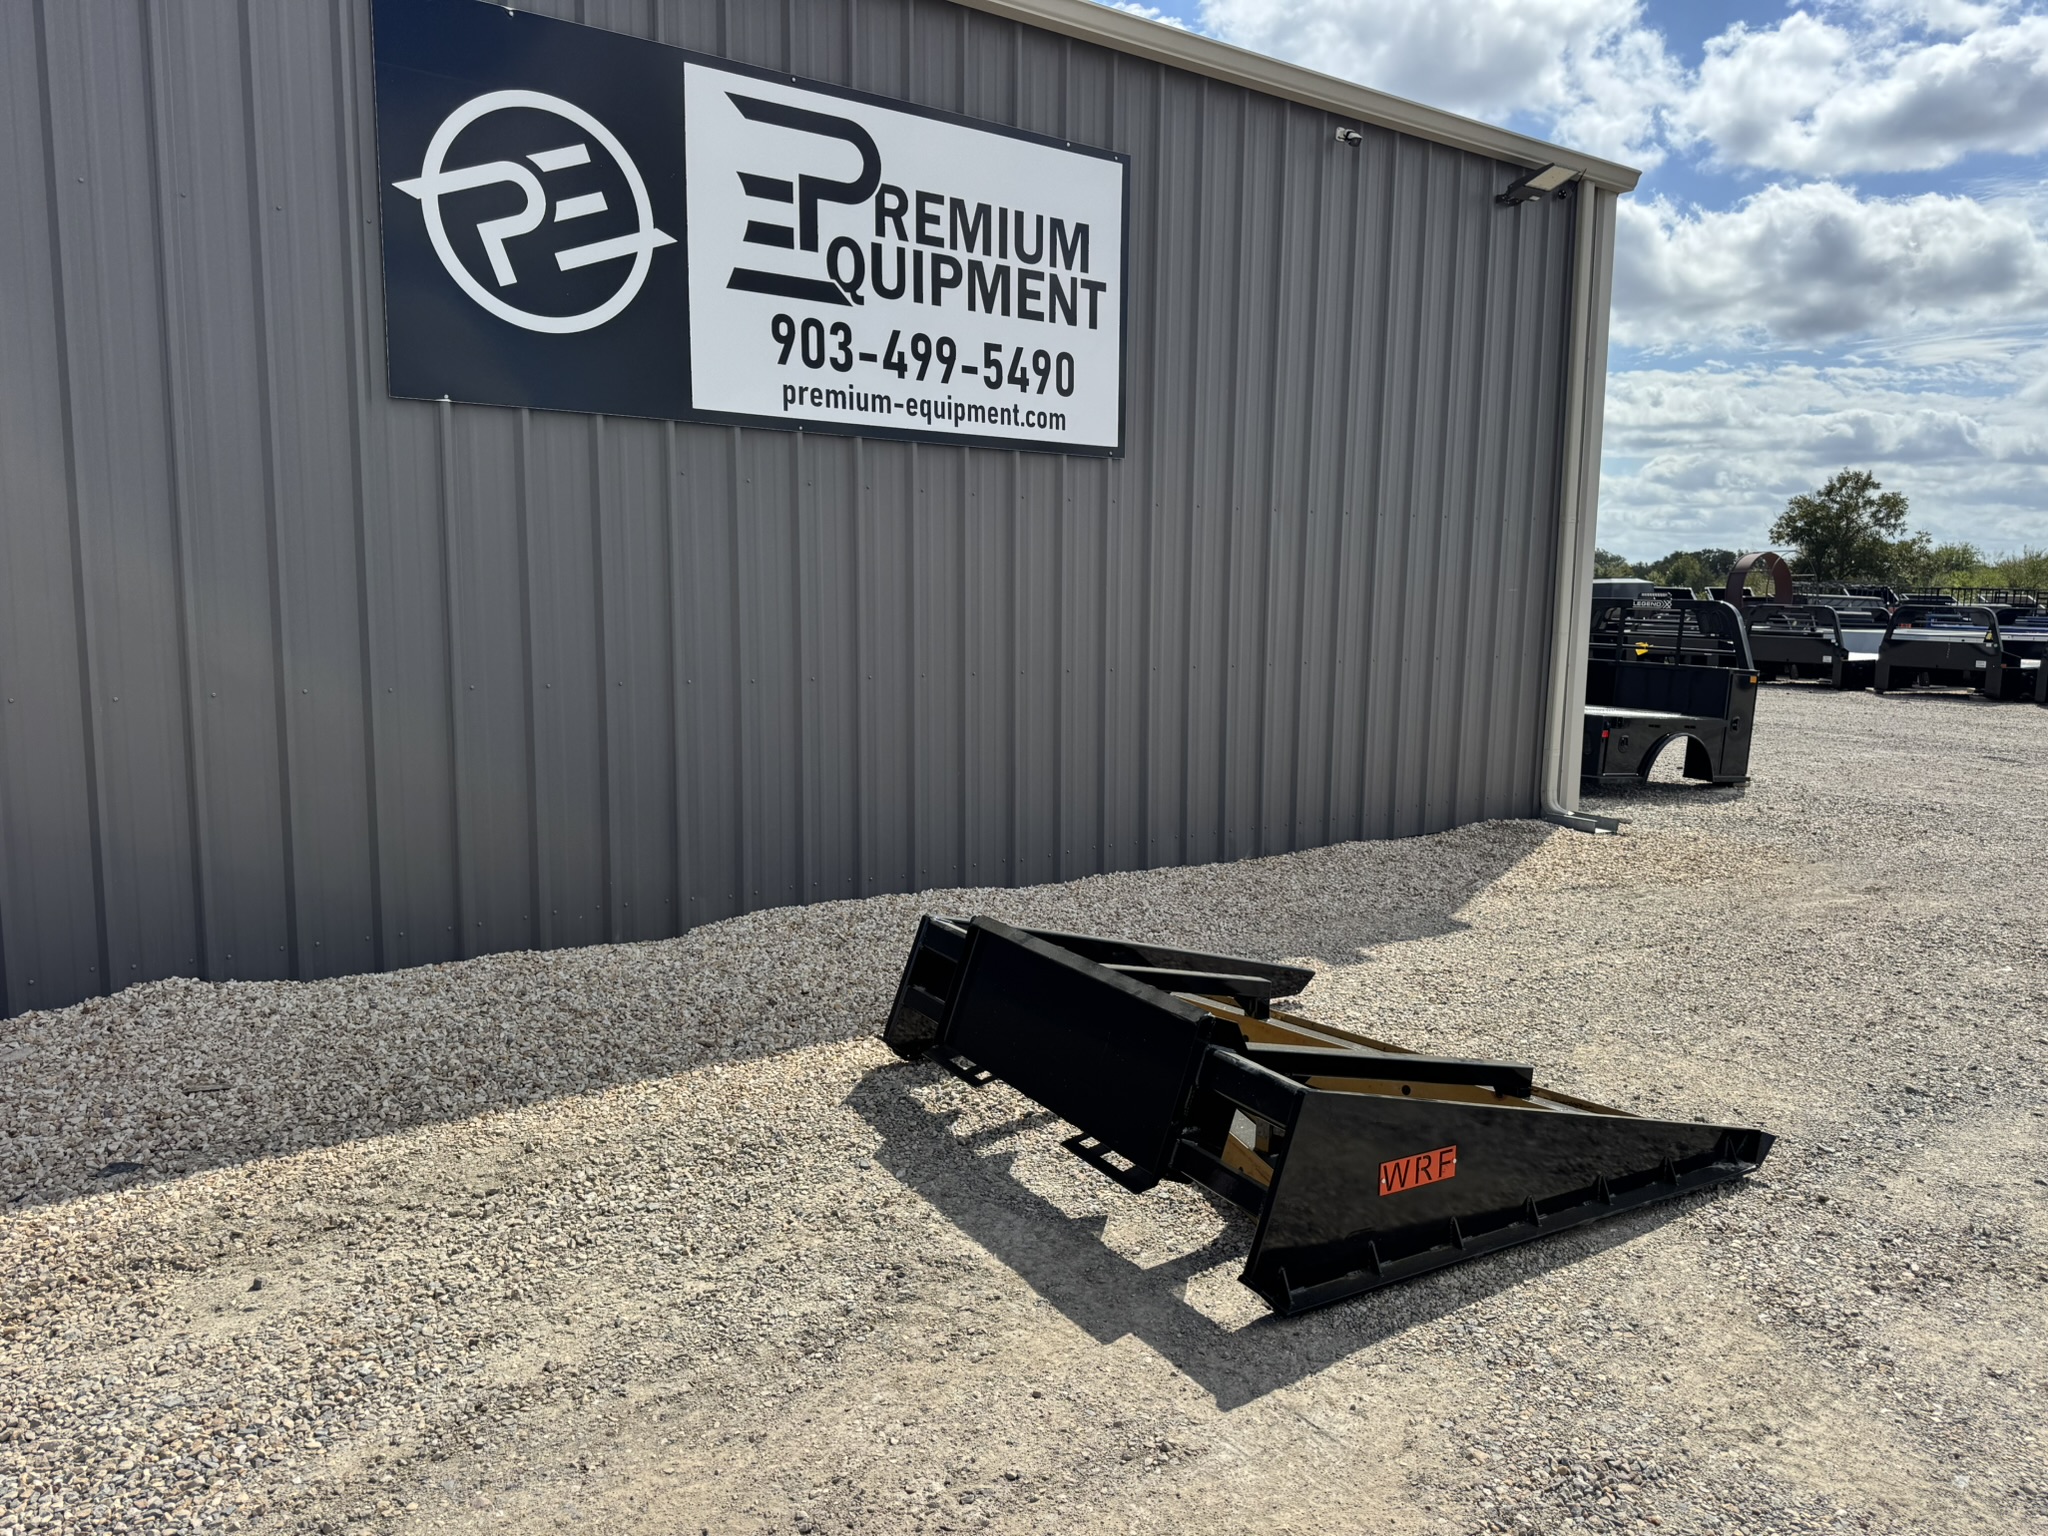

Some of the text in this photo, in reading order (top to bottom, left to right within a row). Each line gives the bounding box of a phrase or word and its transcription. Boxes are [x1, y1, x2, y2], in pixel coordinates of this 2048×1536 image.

[724, 91, 1090, 274] PREMIUM
[726, 170, 1107, 330] EQUIPMENT
[771, 313, 1075, 398] 903-499-5490
[783, 384, 1067, 431] premium-equipment.com
[1383, 1148, 1453, 1191] WRF
